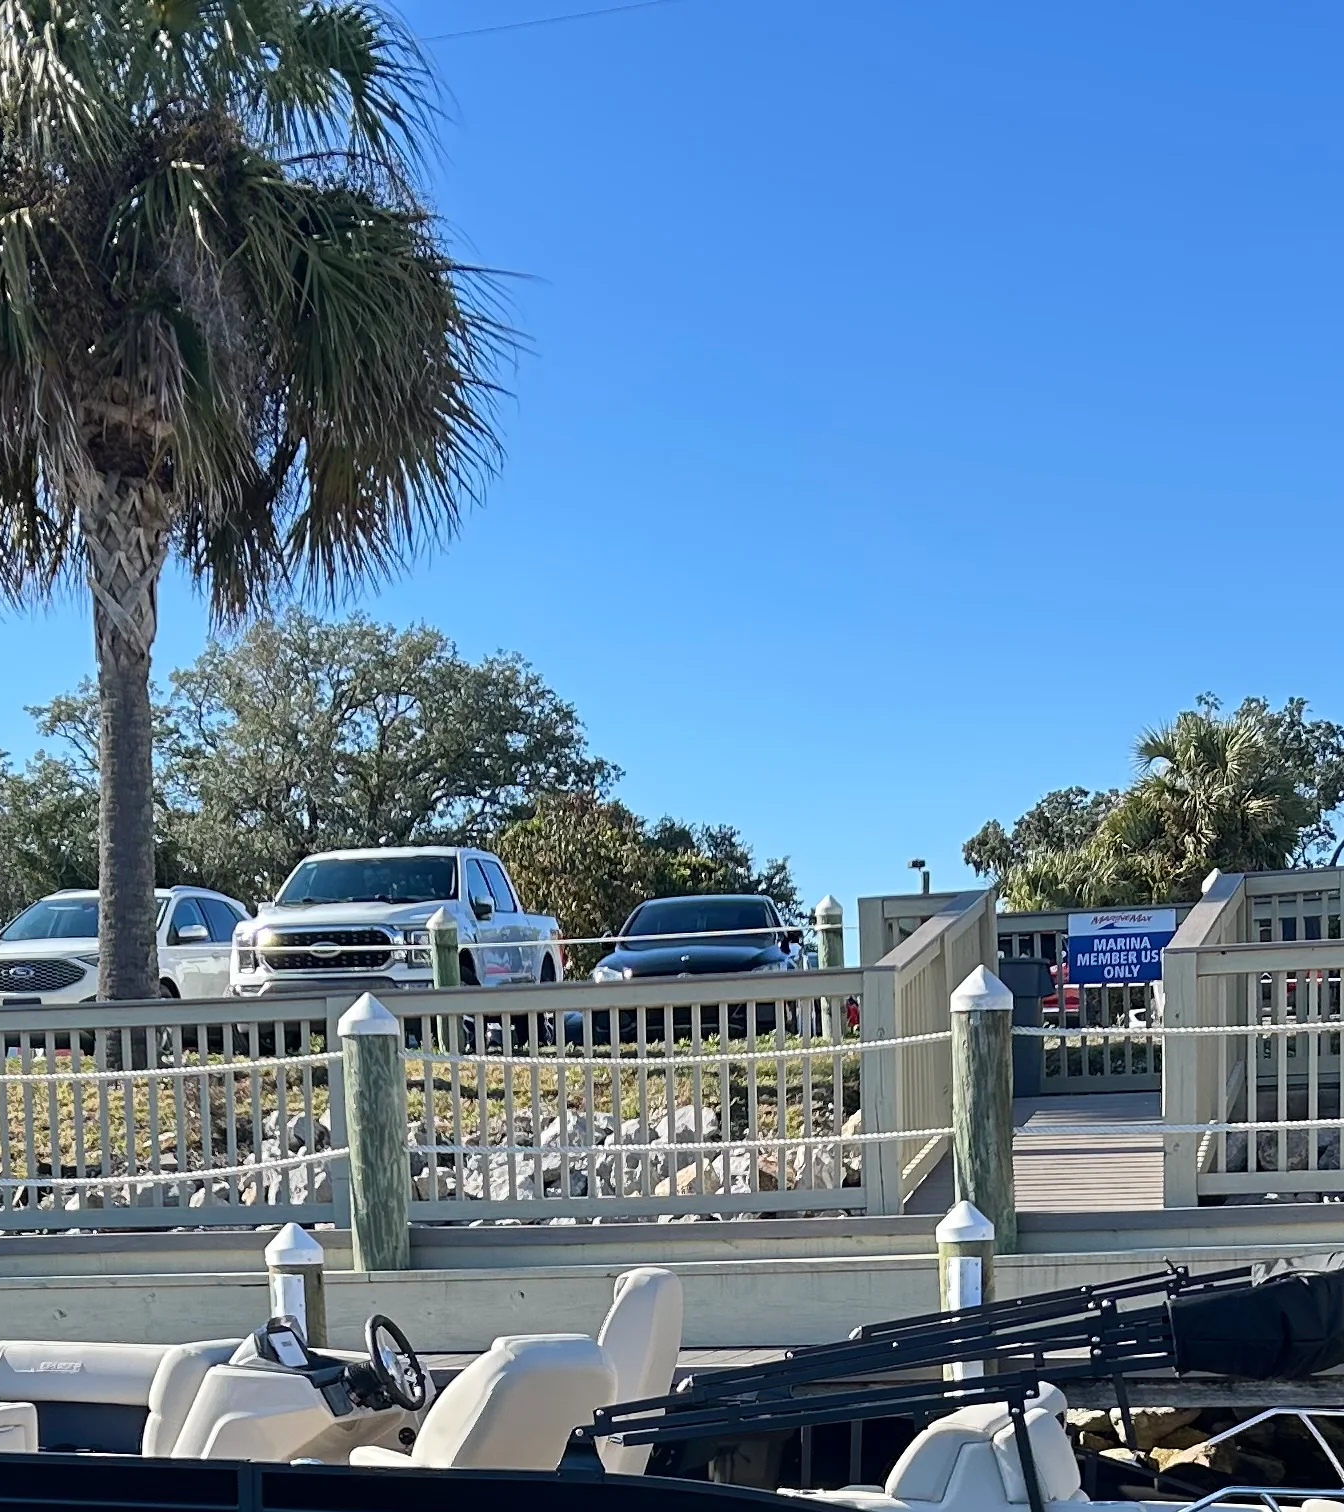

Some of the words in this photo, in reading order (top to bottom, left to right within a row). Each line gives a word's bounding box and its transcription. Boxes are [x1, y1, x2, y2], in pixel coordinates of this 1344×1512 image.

[1093, 936, 1151, 951] MARINA
[1077, 951, 1137, 966] MEMBER
[1141, 950, 1161, 963] US
[1103, 965, 1141, 979] ONLY
